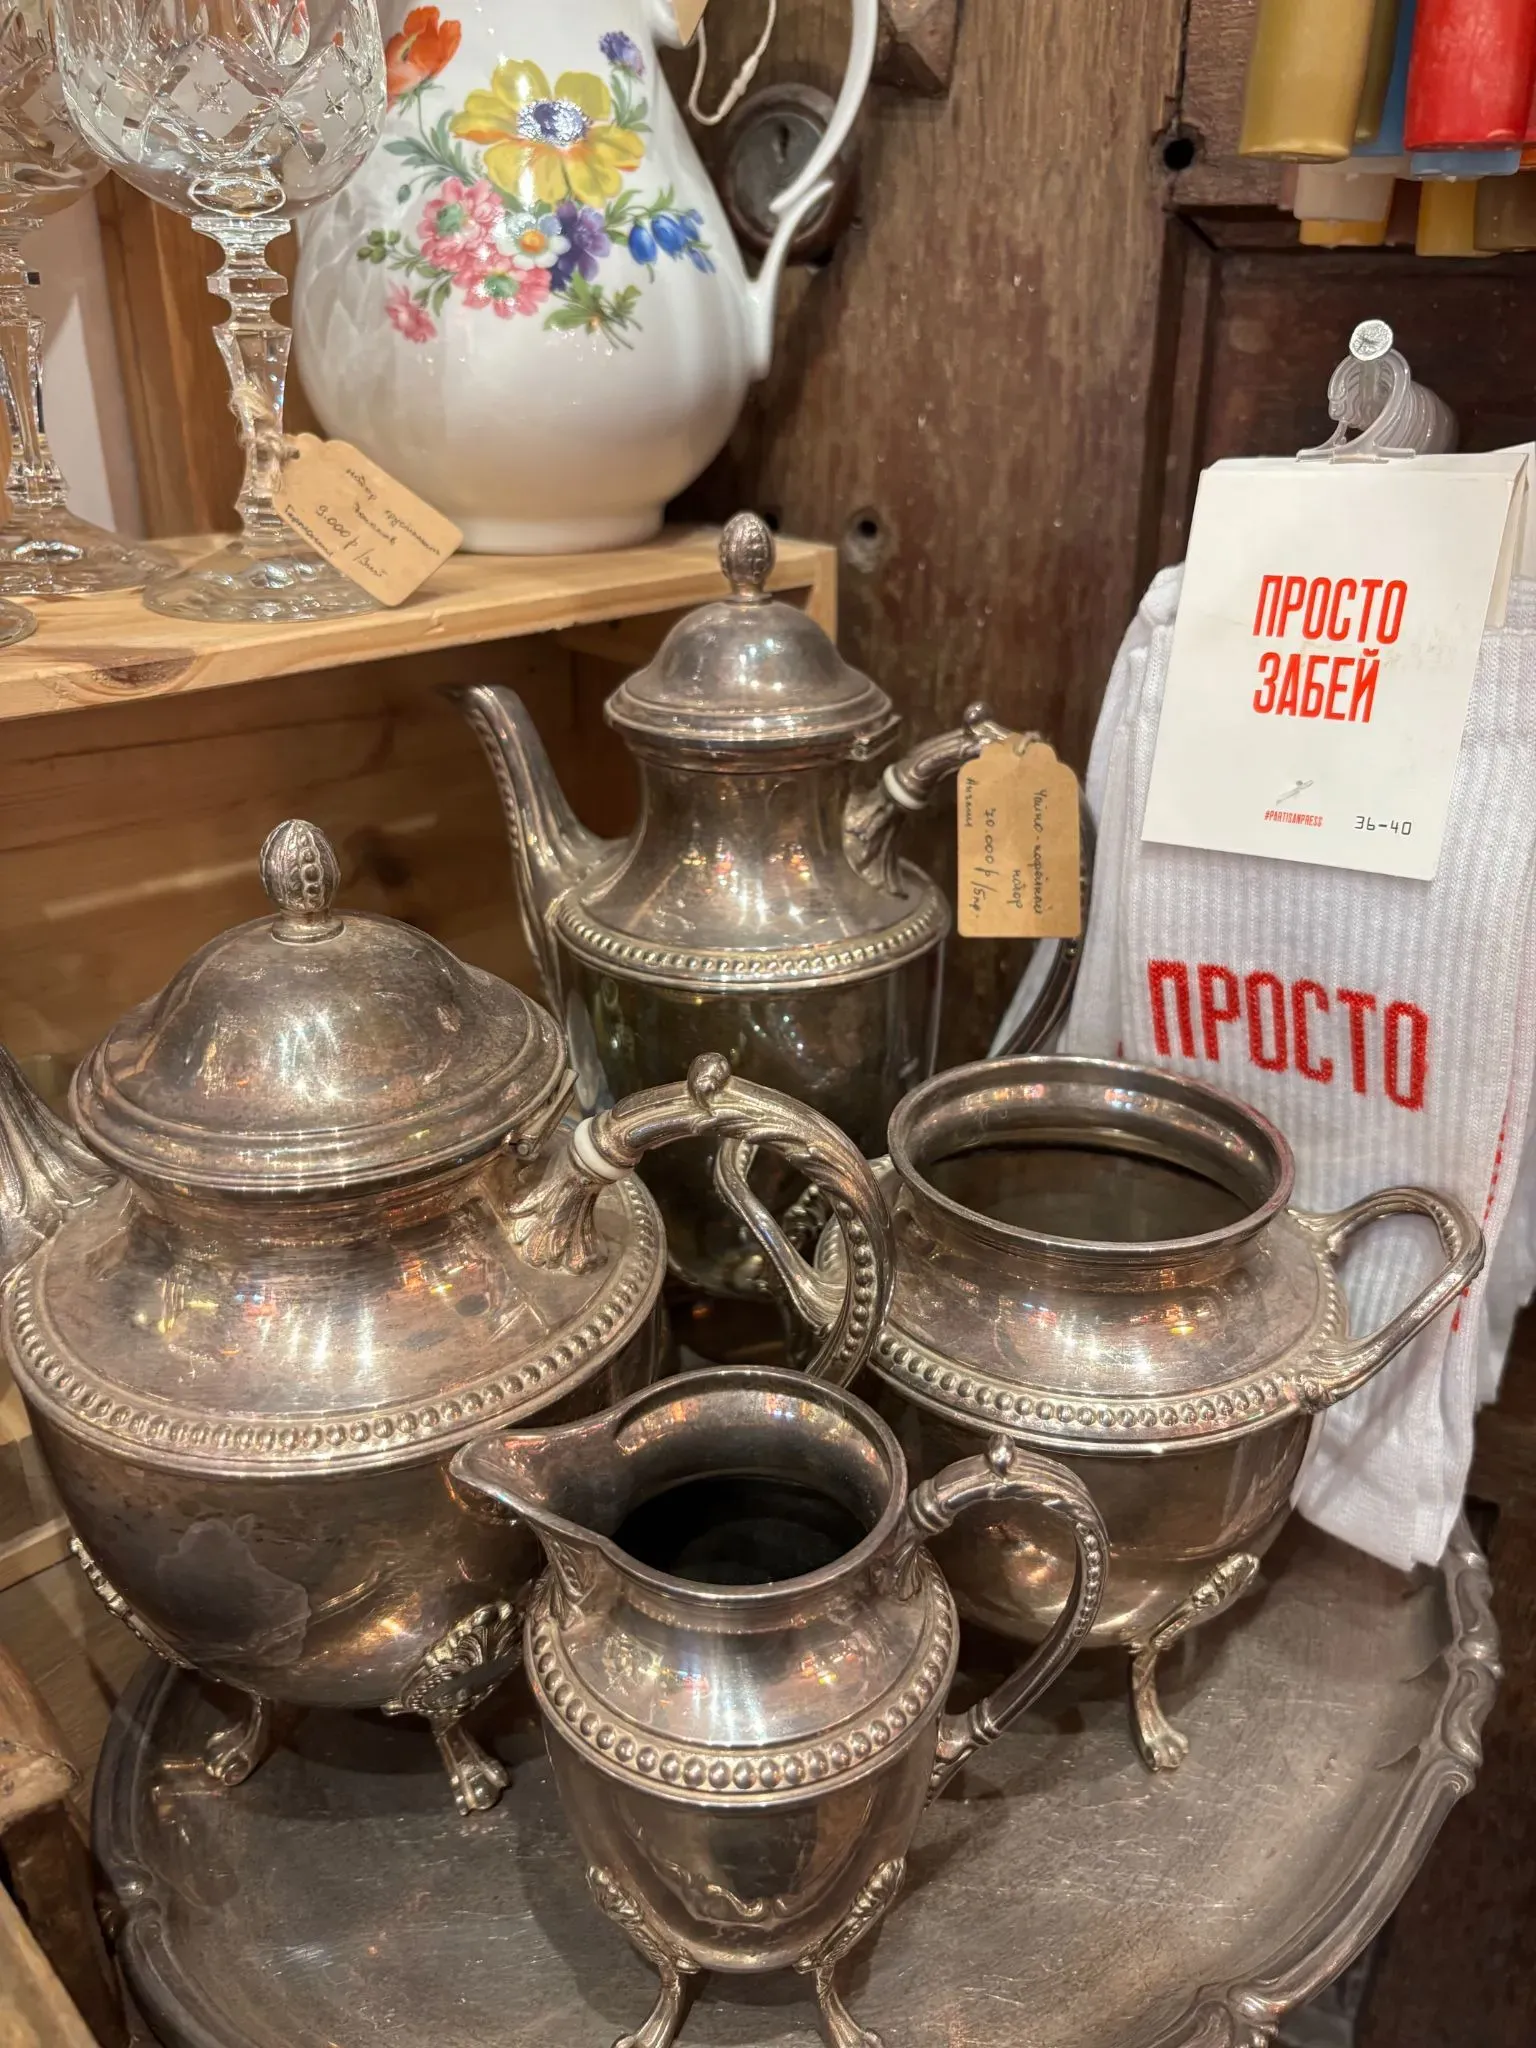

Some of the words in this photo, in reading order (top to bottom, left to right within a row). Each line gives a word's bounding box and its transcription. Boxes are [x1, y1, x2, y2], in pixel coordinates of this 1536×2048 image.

[1253, 574, 1408, 644] ПРОСТО
[1252, 649, 1380, 723] ЗАБЕЙ
[1264, 810, 1324, 827] #PARTISANPRESS
[1354, 815, 1412, 836] 36-40
[1147, 958, 1429, 1111] ПРОСТО
